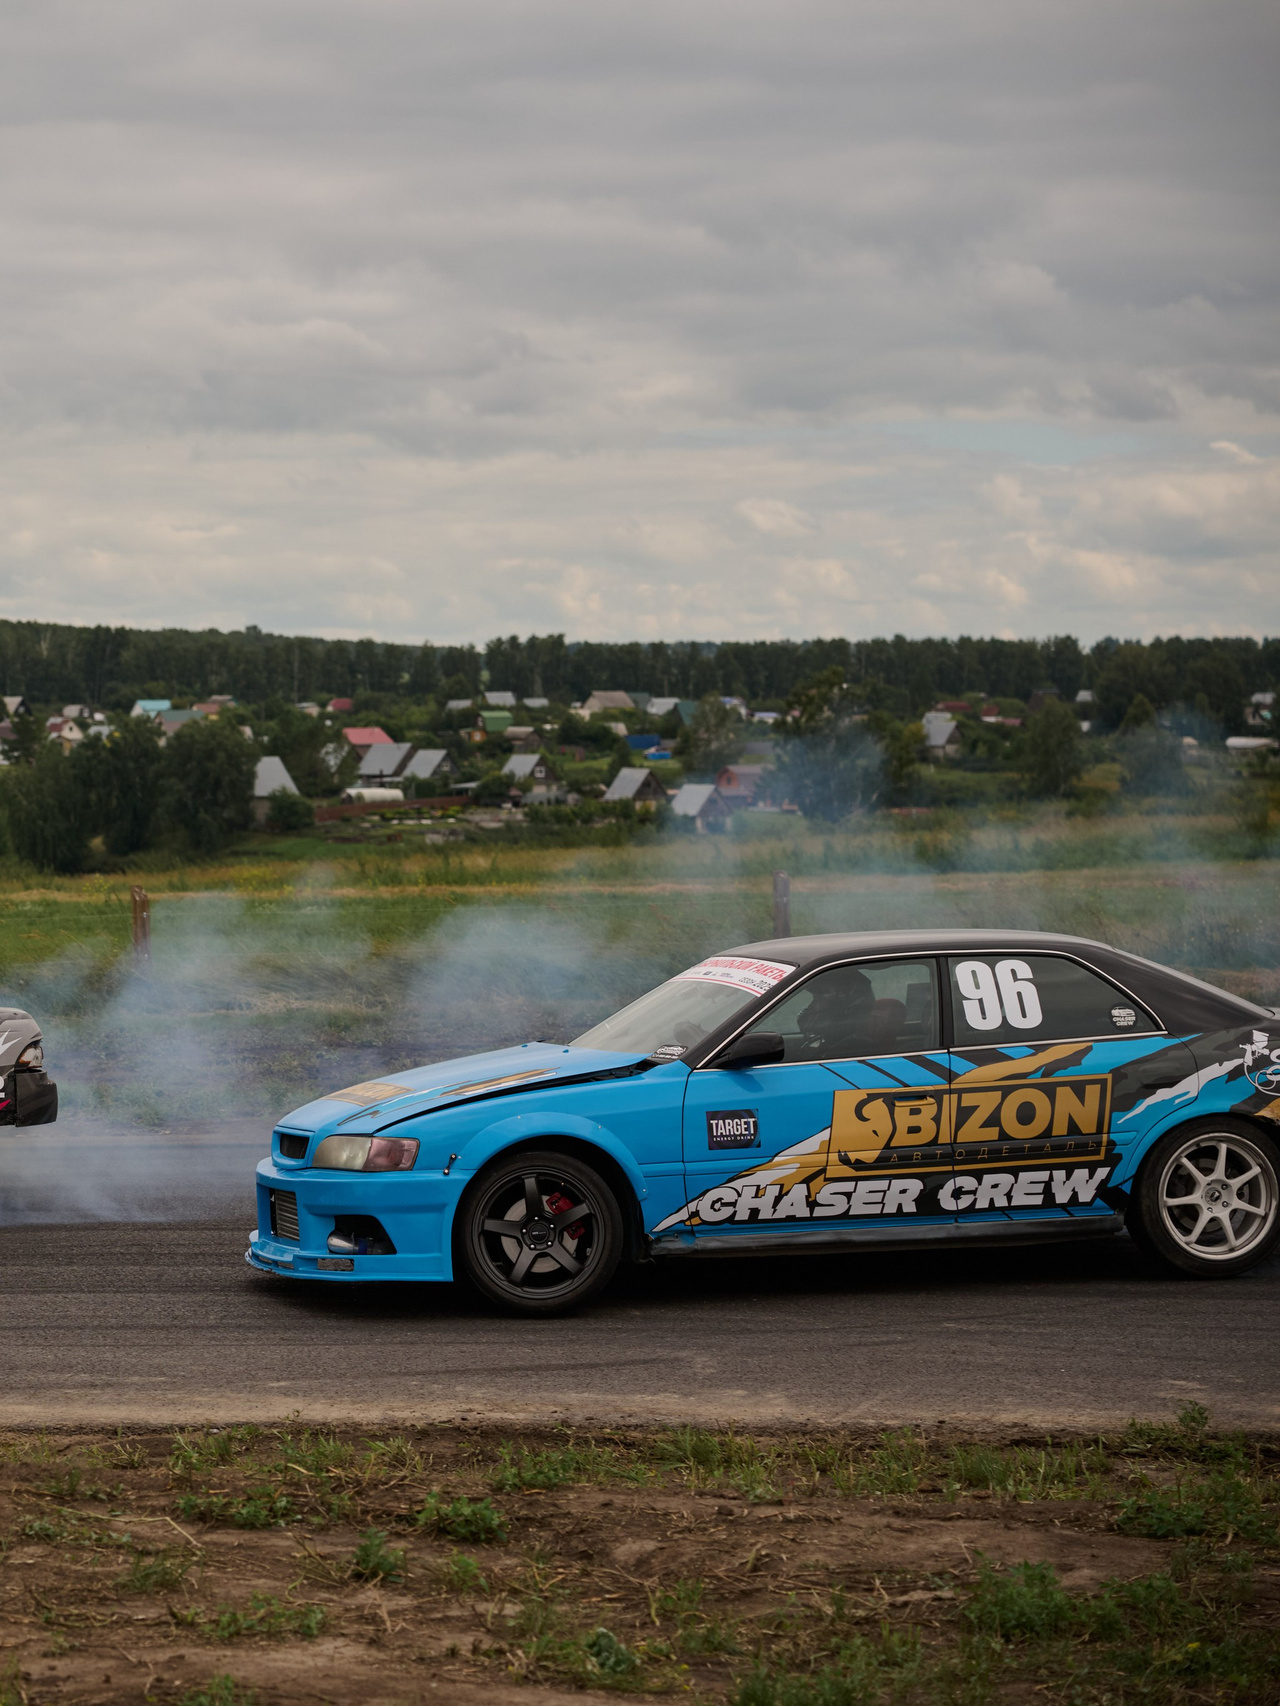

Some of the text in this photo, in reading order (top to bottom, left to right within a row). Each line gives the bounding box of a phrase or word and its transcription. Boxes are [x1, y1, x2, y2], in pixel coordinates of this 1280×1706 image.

[955, 959, 1043, 1031] 96
[710, 1118, 757, 1136] TARGET
[890, 1084, 1101, 1146] BIZON
[890, 1141, 1096, 1163] АВТОДЕТАЛЬ
[696, 1167, 1111, 1221] CHASER CREW
